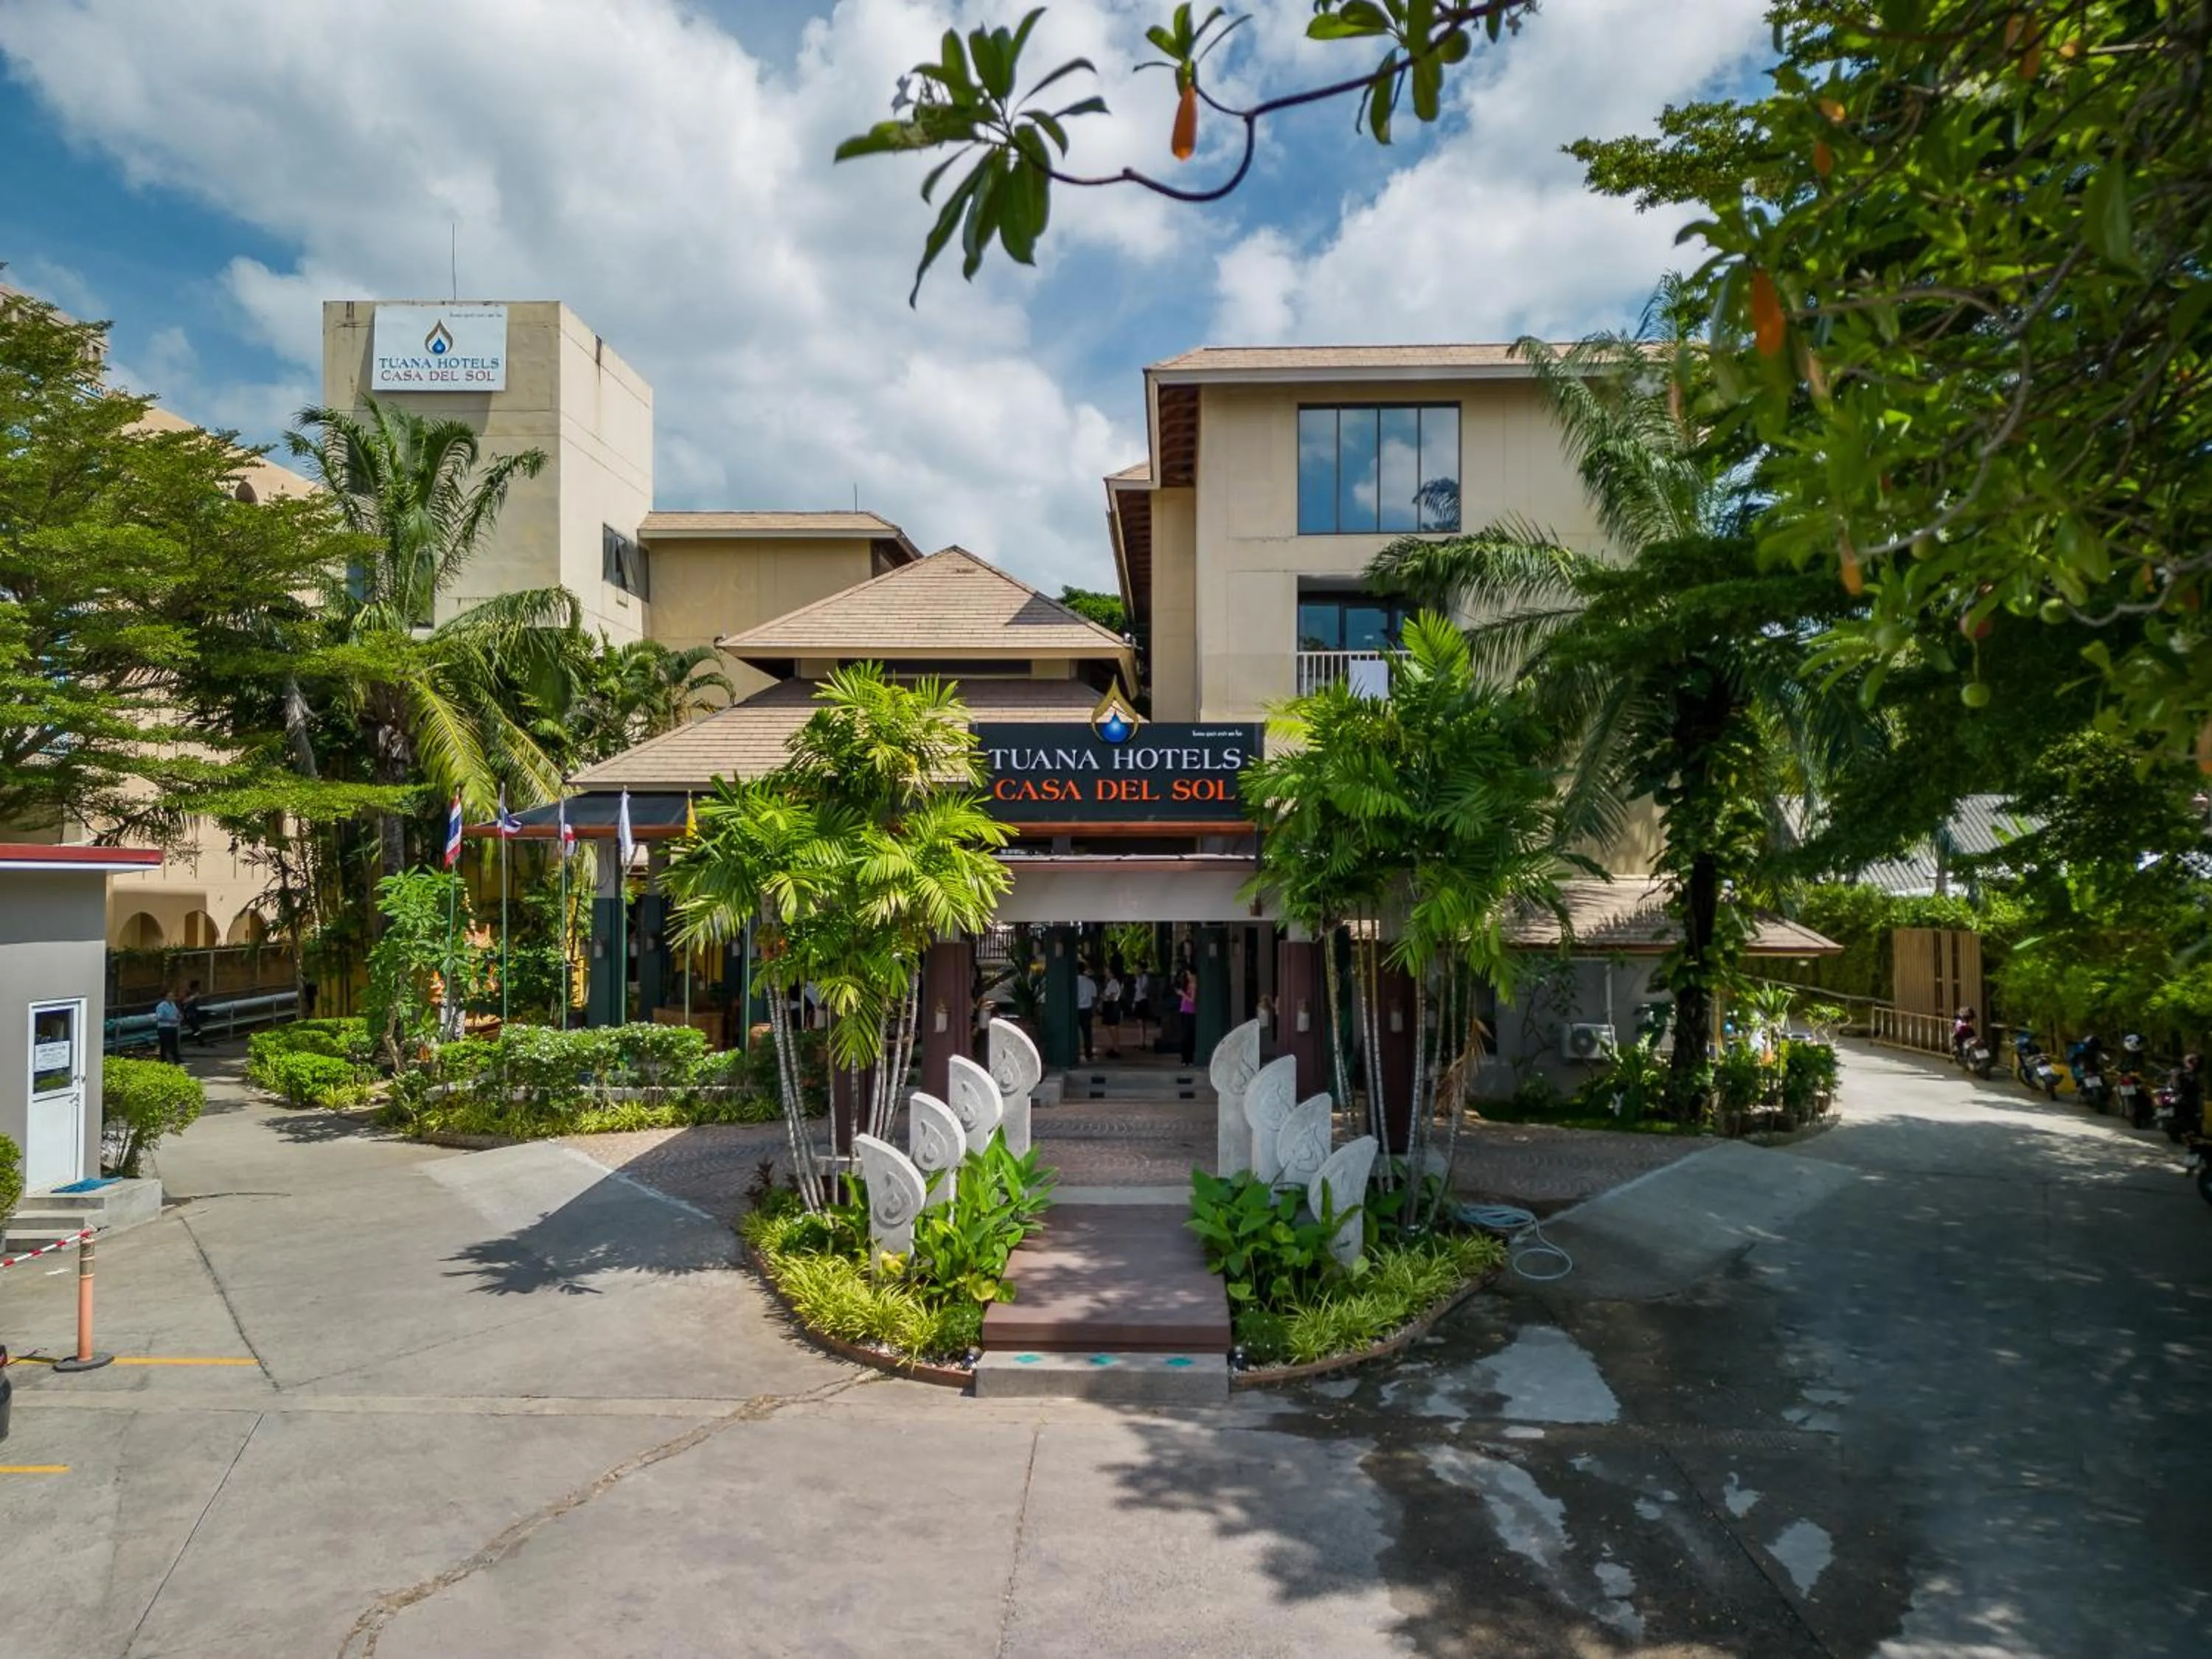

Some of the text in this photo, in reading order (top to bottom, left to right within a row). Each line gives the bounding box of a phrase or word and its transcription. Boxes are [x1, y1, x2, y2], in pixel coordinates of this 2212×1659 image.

[378, 358, 499, 369] TUANA HOTELS
[380, 370, 495, 381] CASA DEL SOL
[988, 748, 1242, 770] TUANA HOTELS
[995, 778, 1236, 801] CASA DEL SOL
